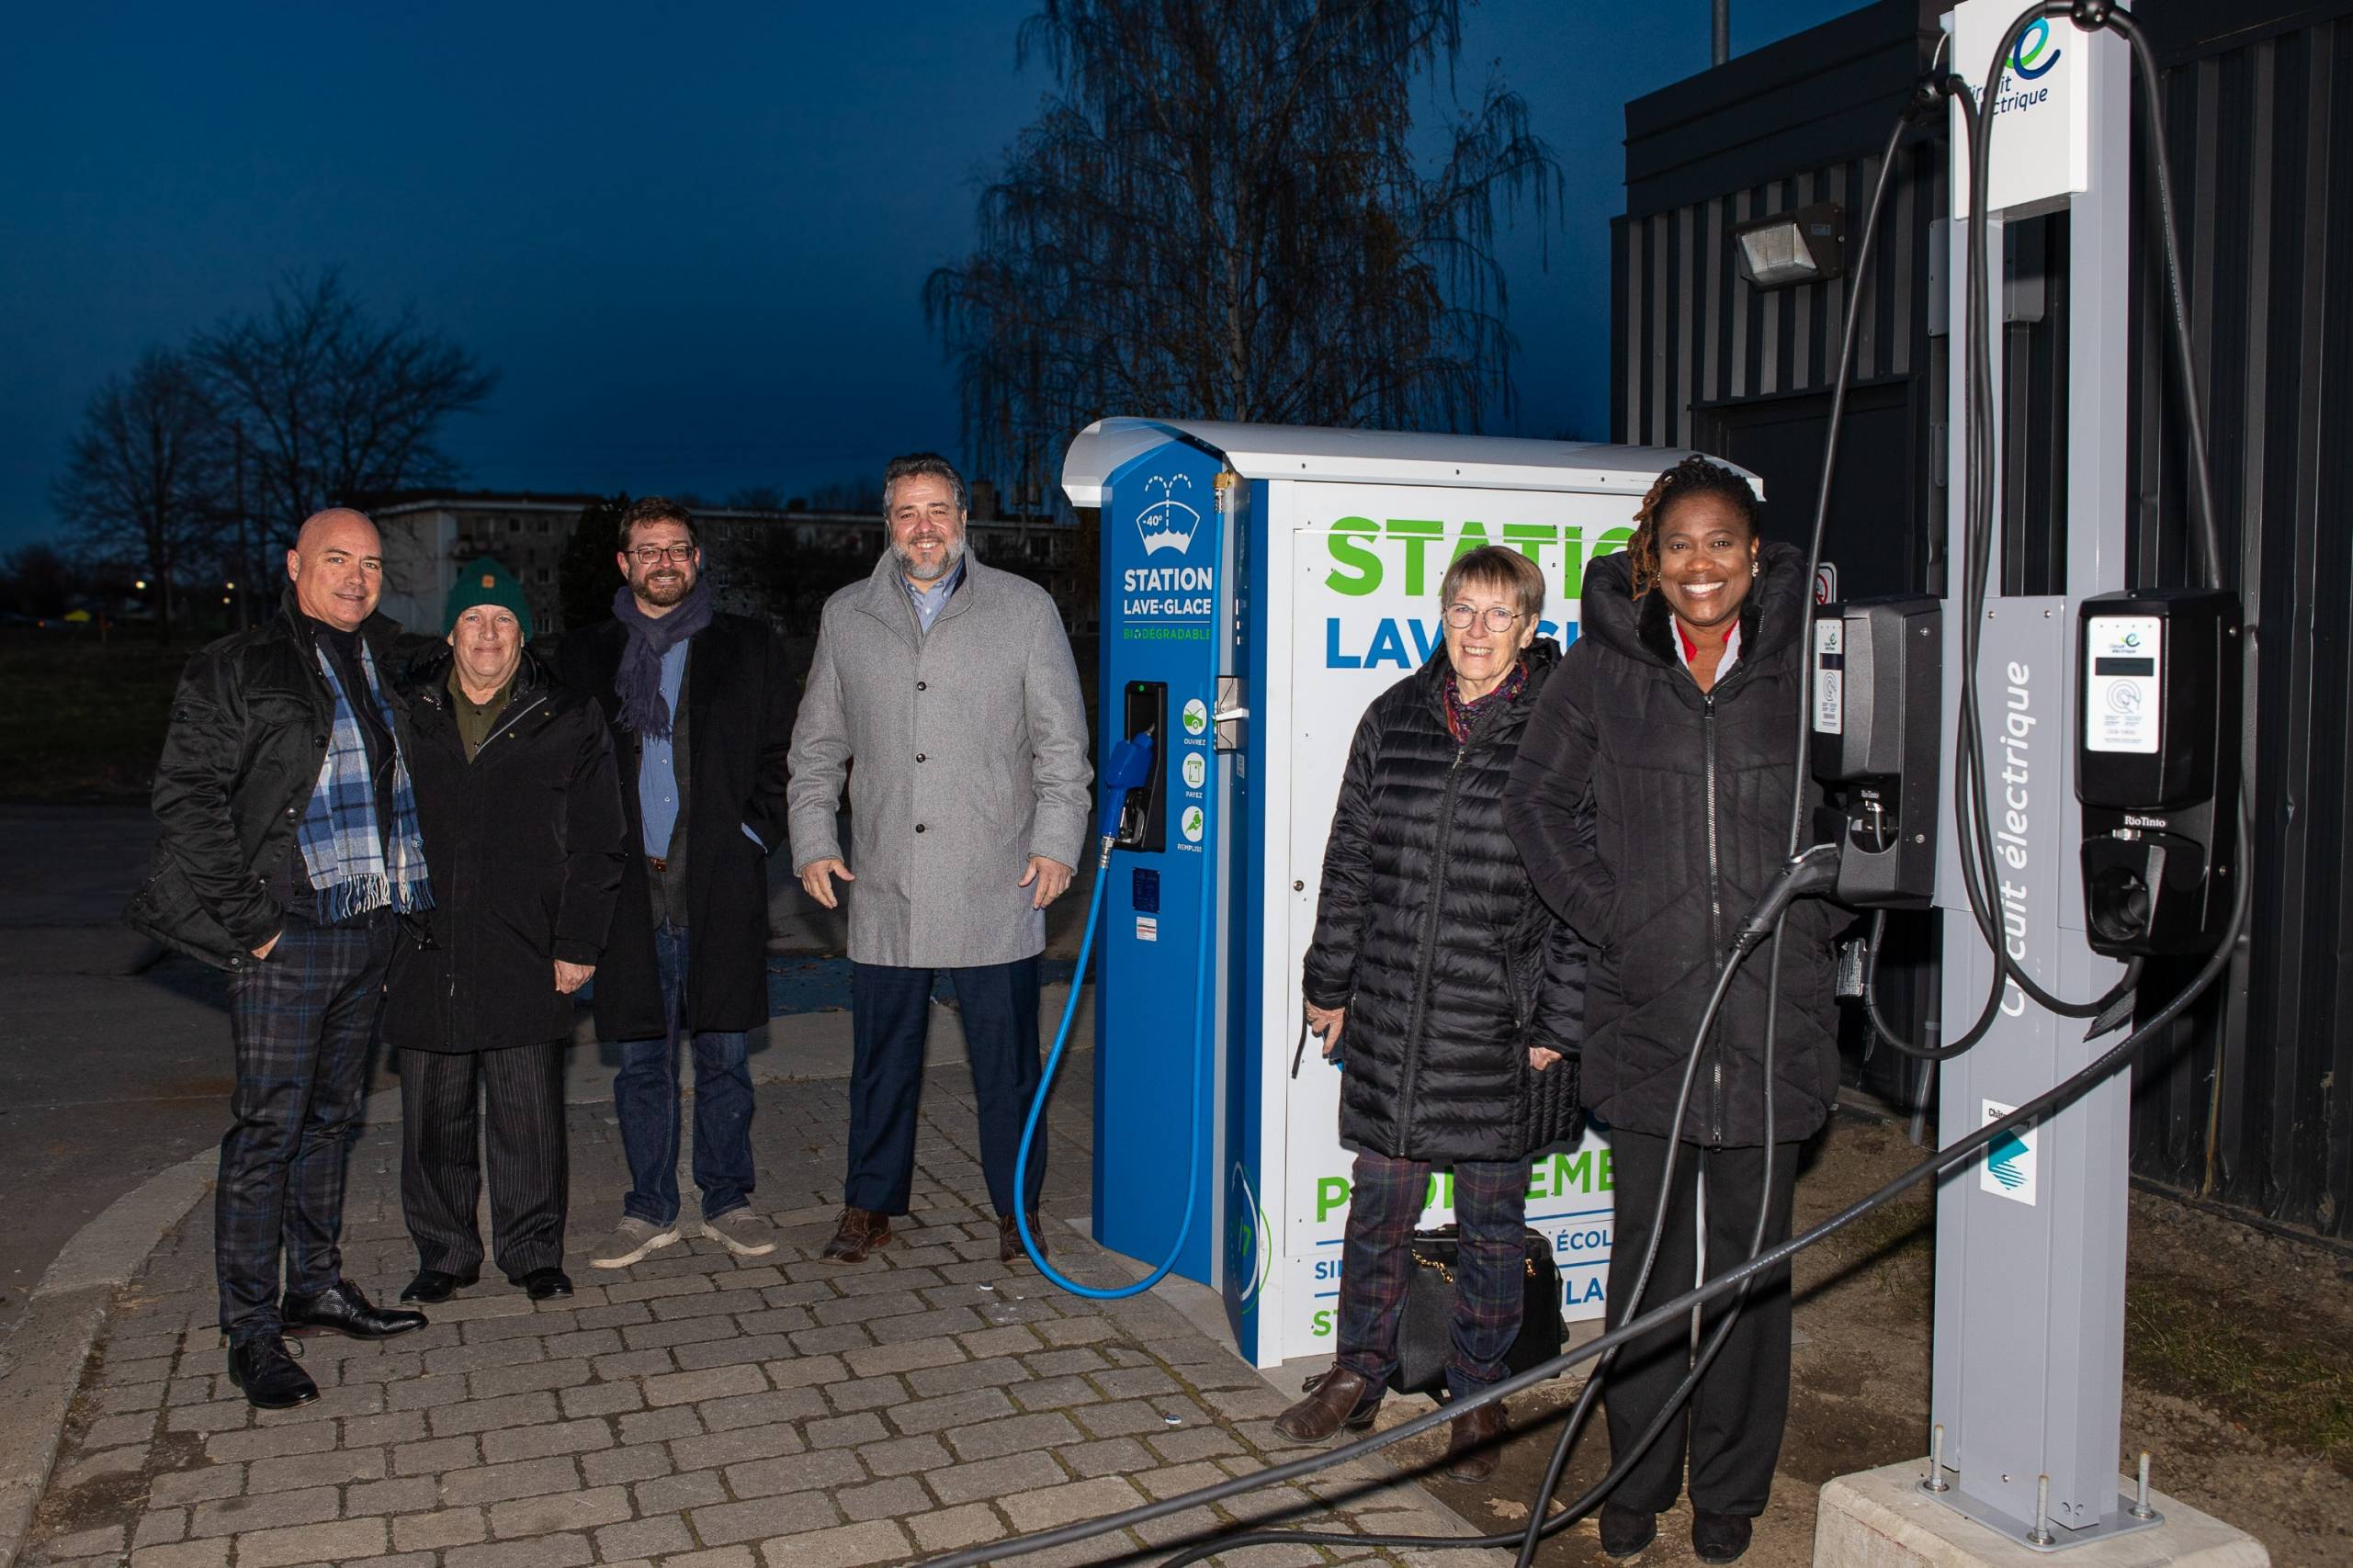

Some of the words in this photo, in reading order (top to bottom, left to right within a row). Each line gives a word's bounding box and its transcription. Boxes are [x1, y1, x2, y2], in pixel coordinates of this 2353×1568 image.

[1970, 76, 2011, 101] irit
[1124, 567, 1213, 592] STATION
[1325, 516, 1638, 600] STATI
[1124, 598, 1212, 615] LAVE-GLACE
[1997, 661, 2036, 869] électrique
[1998, 880, 2027, 1018] Ccuit
